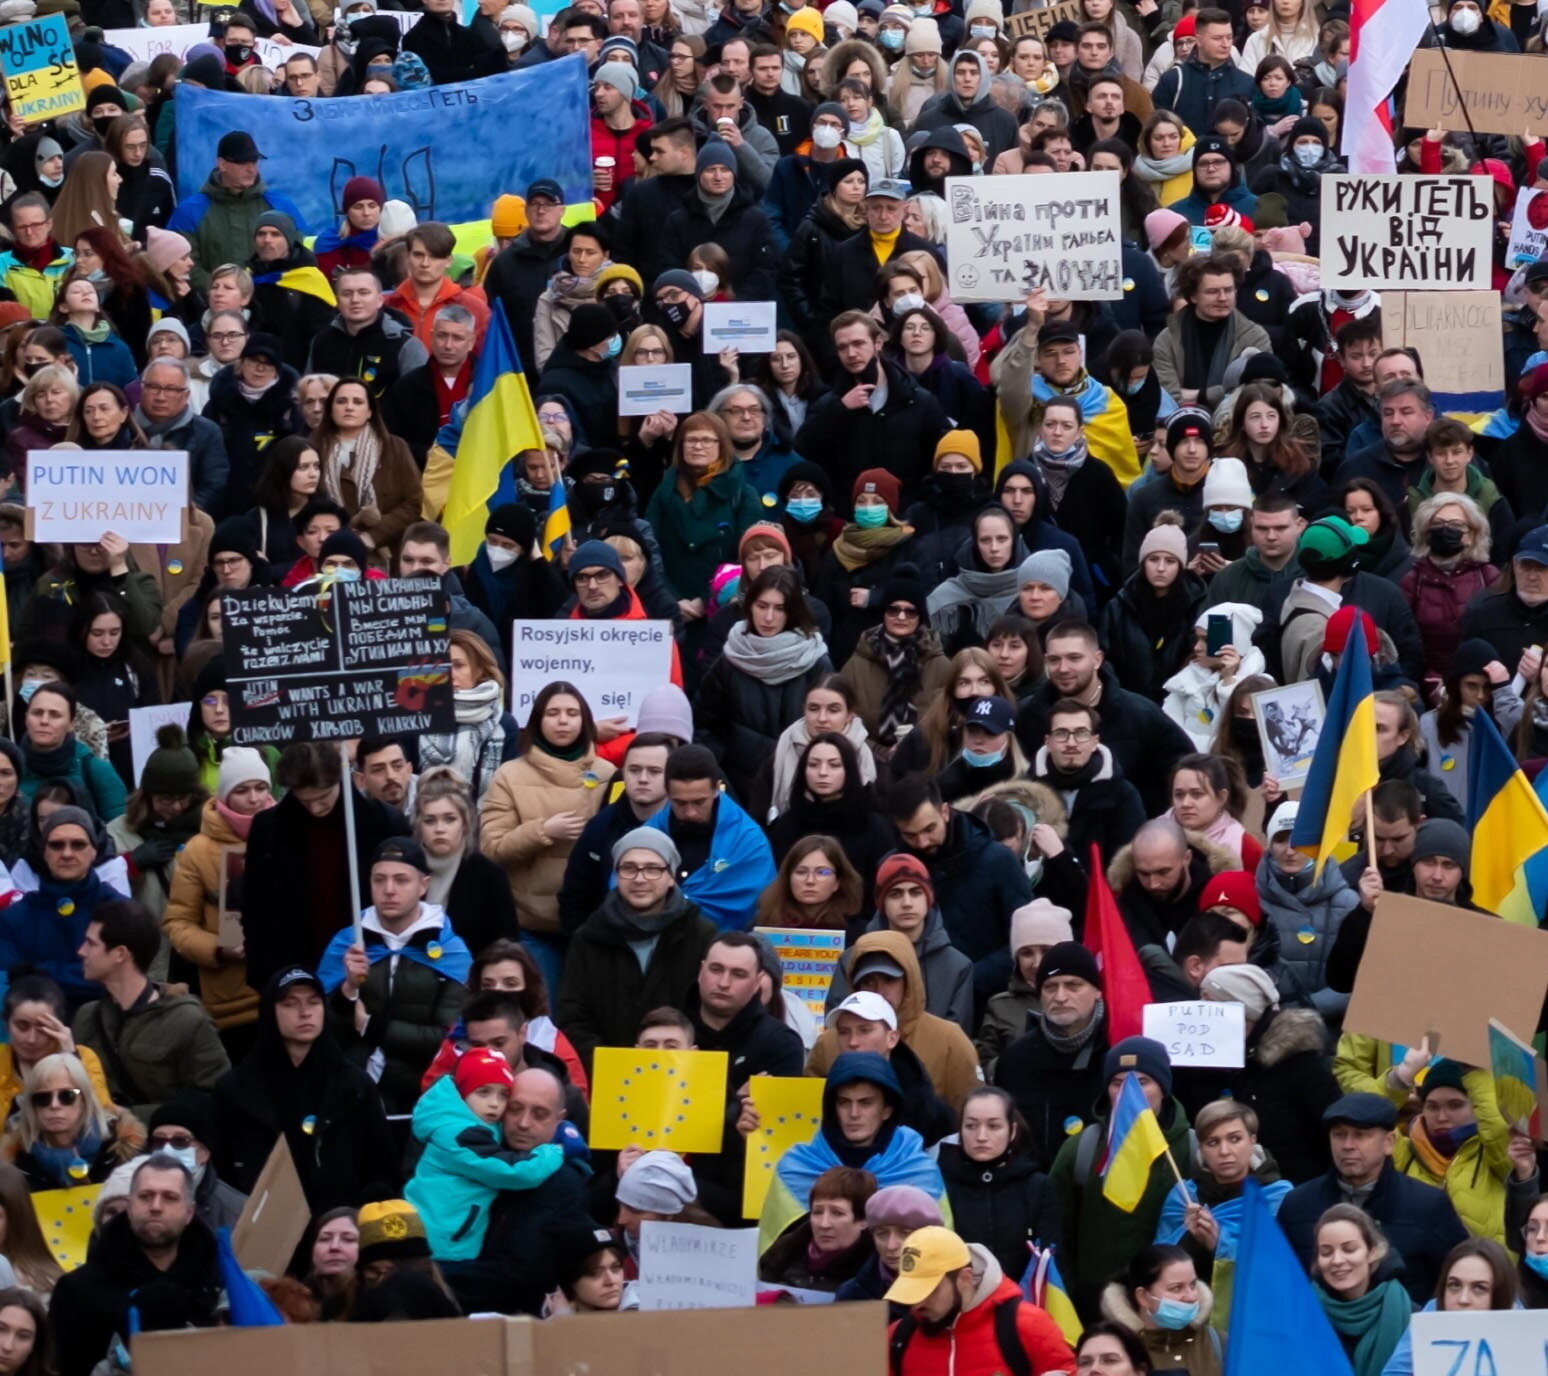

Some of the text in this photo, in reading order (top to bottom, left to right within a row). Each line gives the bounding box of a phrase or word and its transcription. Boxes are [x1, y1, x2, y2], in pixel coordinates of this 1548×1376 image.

[8, 73, 39, 101] DLA
[1425, 68, 1512, 116] Путину
[14, 88, 84, 118] UKRAINY
[1336, 179, 1489, 221] РУКИ ГЕТЬ
[1390, 211, 1442, 248] ВІД
[1336, 234, 1479, 283] УКРАЇНИ
[35, 465, 178, 487] PUTIN WON
[42, 499, 171, 523] Z UKRAINY
[344, 582, 375, 598] МЫ
[348, 598, 433, 616] МЫ СИЛЬНЫ
[520, 625, 665, 648] Rosyjski okręcie
[519, 655, 597, 674] wojenny,
[287, 678, 385, 703] WANTS A WAR
[600, 688, 631, 709] się!
[278, 692, 398, 721] WITH UKRAINE
[234, 725, 294, 745] CHARKÓW
[1167, 1004, 1225, 1018] PUTIN
[1176, 1023, 1211, 1036] POD
